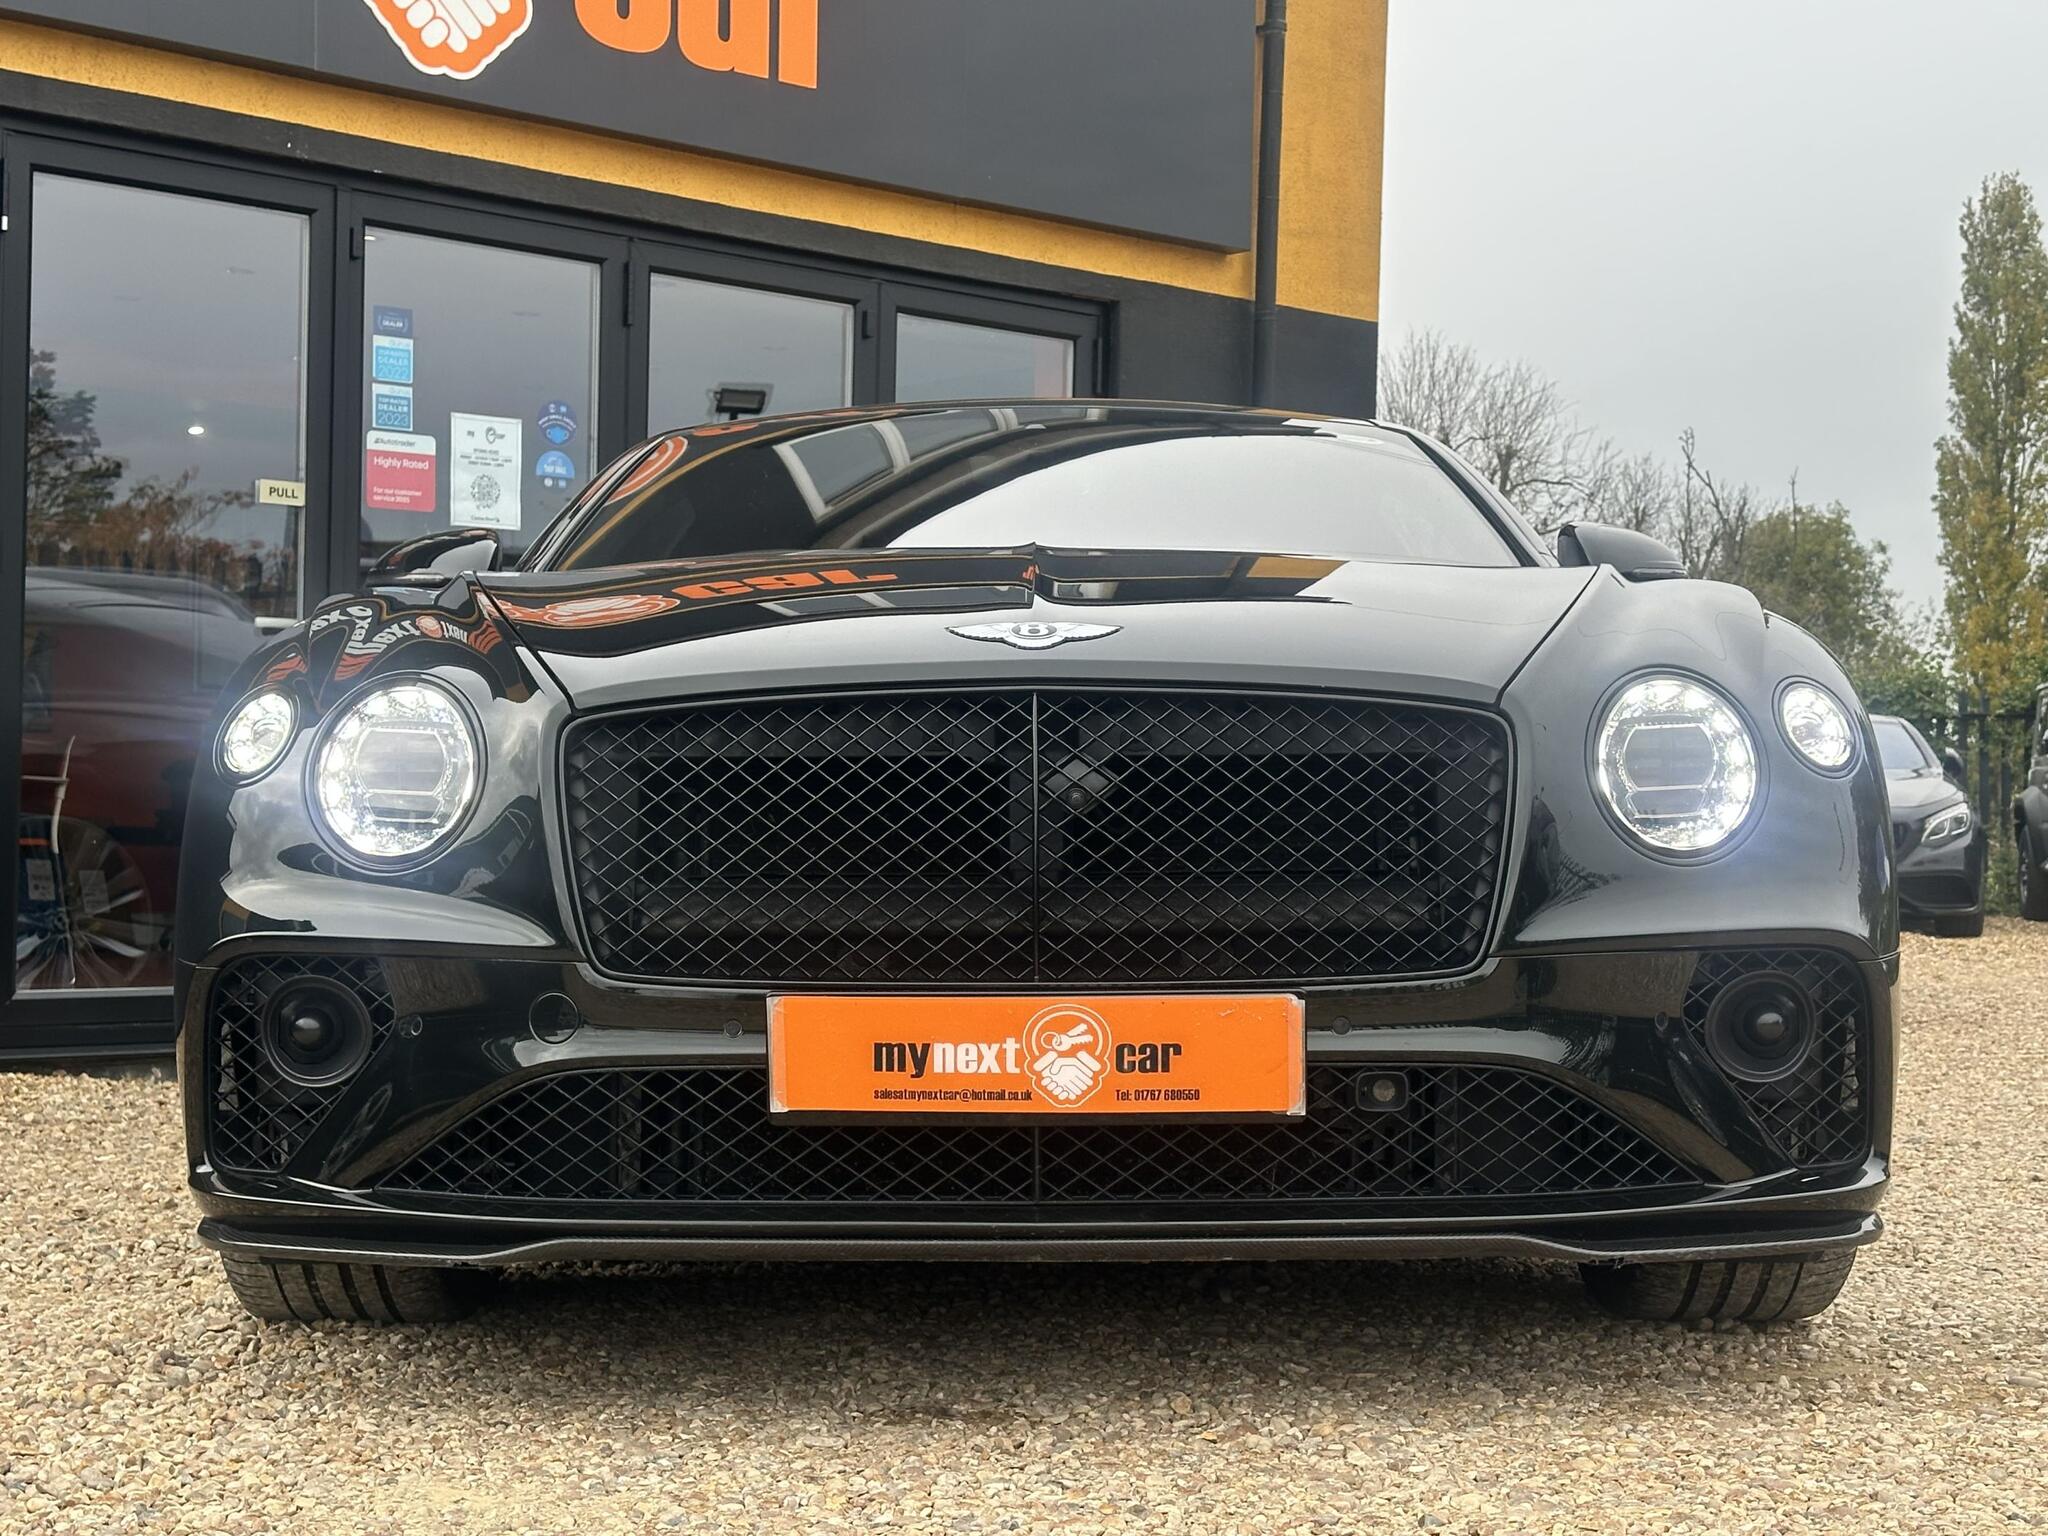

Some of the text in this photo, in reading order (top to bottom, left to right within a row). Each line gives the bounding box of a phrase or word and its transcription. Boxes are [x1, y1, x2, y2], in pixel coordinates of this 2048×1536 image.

[378, 403, 409, 412] DEALER
[378, 411, 409, 426] 2023
[374, 455, 429, 471] Highly Rated
[269, 486, 299, 499] PULL
[873, 1037, 1183, 1079] mynext car
[873, 1088, 1201, 1102] salesatmynextcar@hotmail.co.uk Tel: 01767 680550
